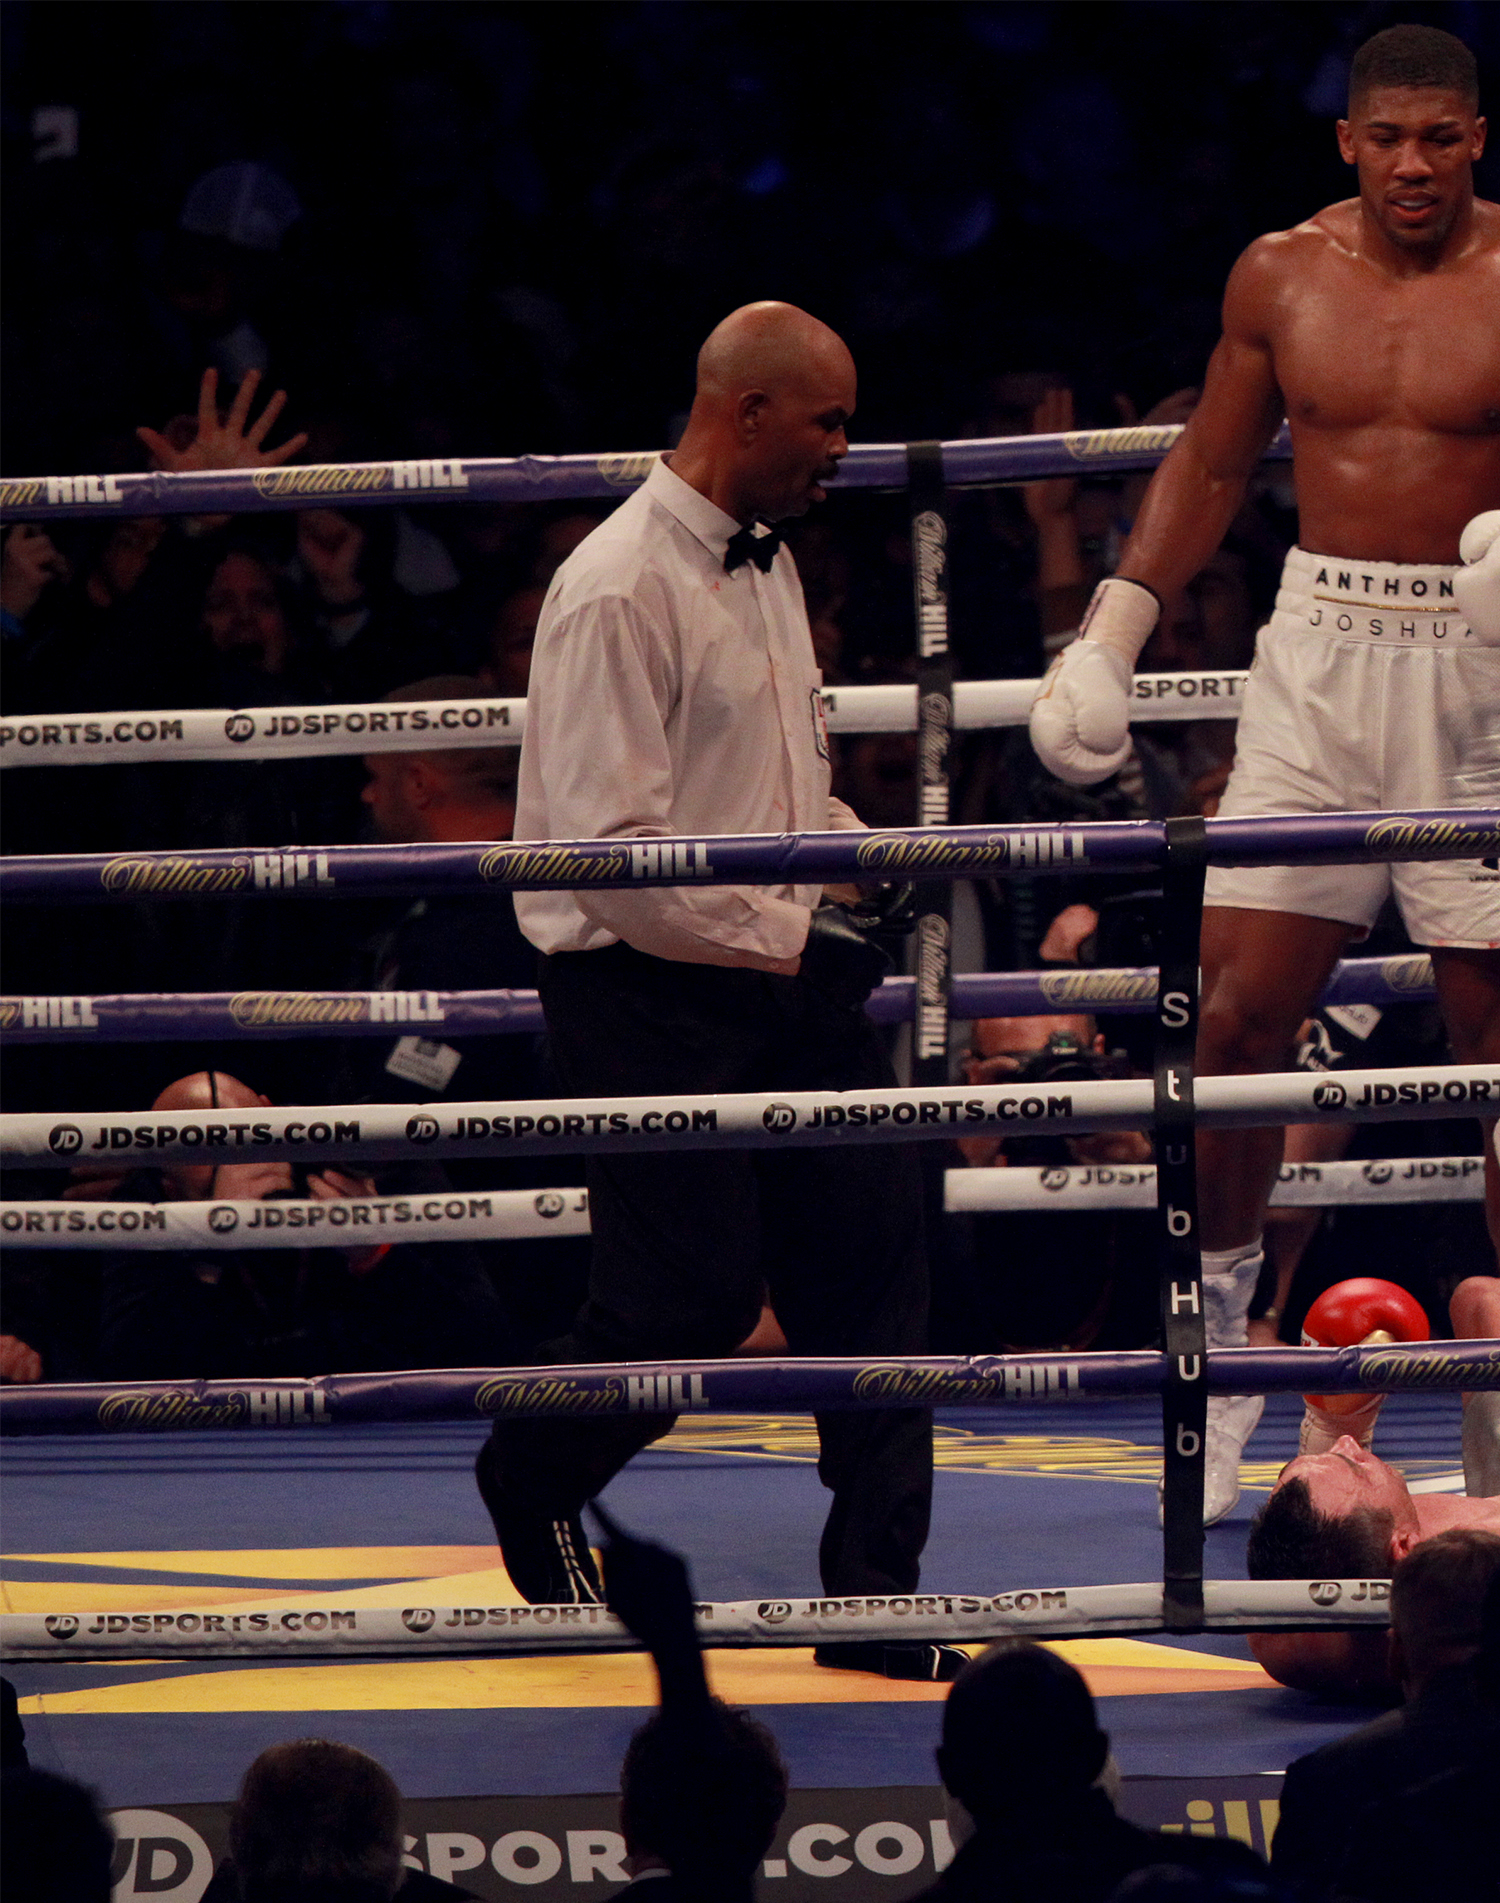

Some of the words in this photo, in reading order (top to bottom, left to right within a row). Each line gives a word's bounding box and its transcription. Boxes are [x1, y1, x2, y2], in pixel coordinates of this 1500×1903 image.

[47, 475, 123, 504] HILL
[393, 460, 468, 488] HILL
[1136, 676, 1249, 699] SPORT
[264, 706, 510, 738] JDSPORTS.COM
[479, 843, 630, 882] William
[631, 843, 714, 878] HILL
[857, 833, 1008, 869] William
[1009, 832, 1090, 867] HILL
[101, 856, 252, 892] William
[254, 854, 335, 888] HILL
[23, 997, 99, 1028] HILL
[369, 992, 444, 1022] HILL
[448, 1109, 718, 1141] JDSPORTS.COM
[804, 1095, 1073, 1129] JDSPORTS.COM
[92, 1120, 361, 1150] JDSPORTS.COM
[247, 1199, 492, 1229] JDSPORTS.COM
[475, 1376, 625, 1413] William
[627, 1374, 709, 1409] HILL
[854, 1362, 1002, 1399] William
[1003, 1365, 1085, 1397] HILL
[99, 1391, 249, 1428] William
[250, 1390, 331, 1424] HILL
[801, 1591, 1067, 1618] JDSPORTS.COM
[88, 1610, 357, 1634] JDSPORTS.COM
